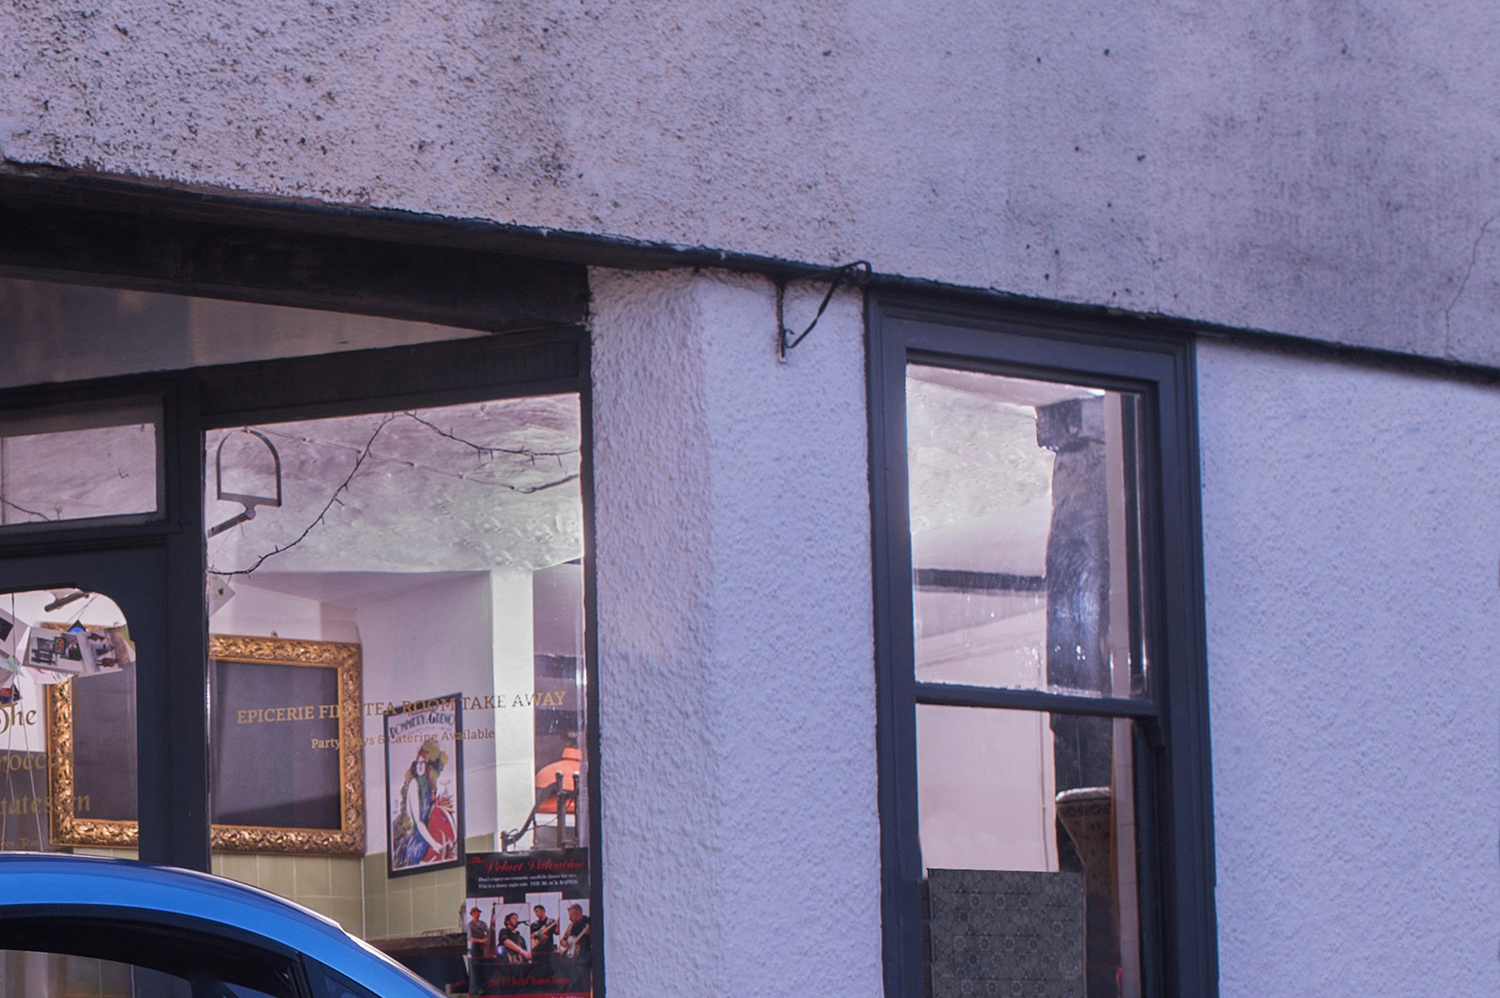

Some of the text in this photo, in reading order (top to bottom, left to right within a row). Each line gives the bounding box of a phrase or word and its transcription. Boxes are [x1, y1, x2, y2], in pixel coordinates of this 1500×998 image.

[237, 706, 315, 724] EPICERIE
[363, 701, 397, 716] TEA
[401, 697, 456, 715] ROOM
[461, 694, 506, 711] TAKE
[512, 691, 567, 708] AWAY
[311, 736, 340, 749] Party
[441, 728, 495, 742] Available
